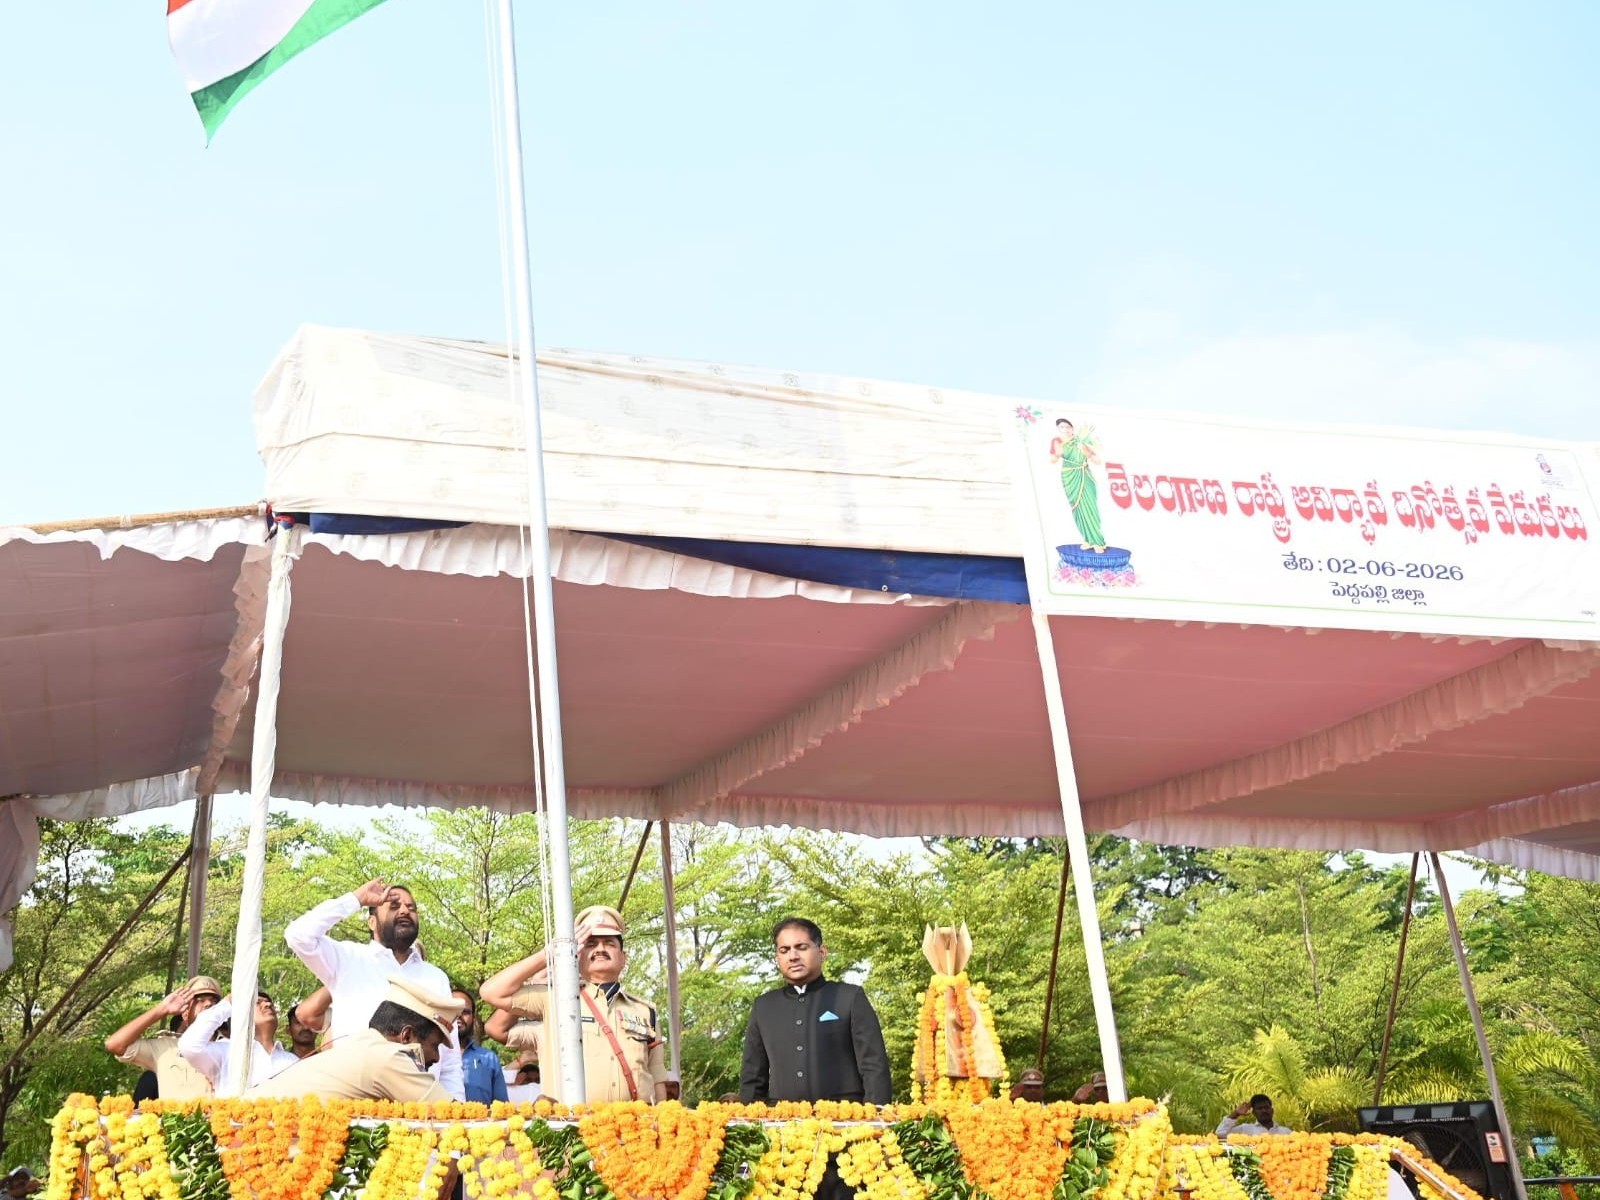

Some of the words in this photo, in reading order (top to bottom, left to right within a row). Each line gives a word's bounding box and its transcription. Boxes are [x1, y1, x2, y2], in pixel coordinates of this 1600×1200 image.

[1105, 462, 1228, 517] తెలంగాణ
[1231, 472, 1292, 544] రాష్ట్ర
[1391, 480, 1490, 545] దినోత్సవ
[1486, 482, 1588, 541] వేడుకలు
[1326, 557, 1465, 581] 02-06-2026
[1329, 581, 1390, 605] పెద్దపల్లి
[1391, 588, 1428, 606] జిల్లా
